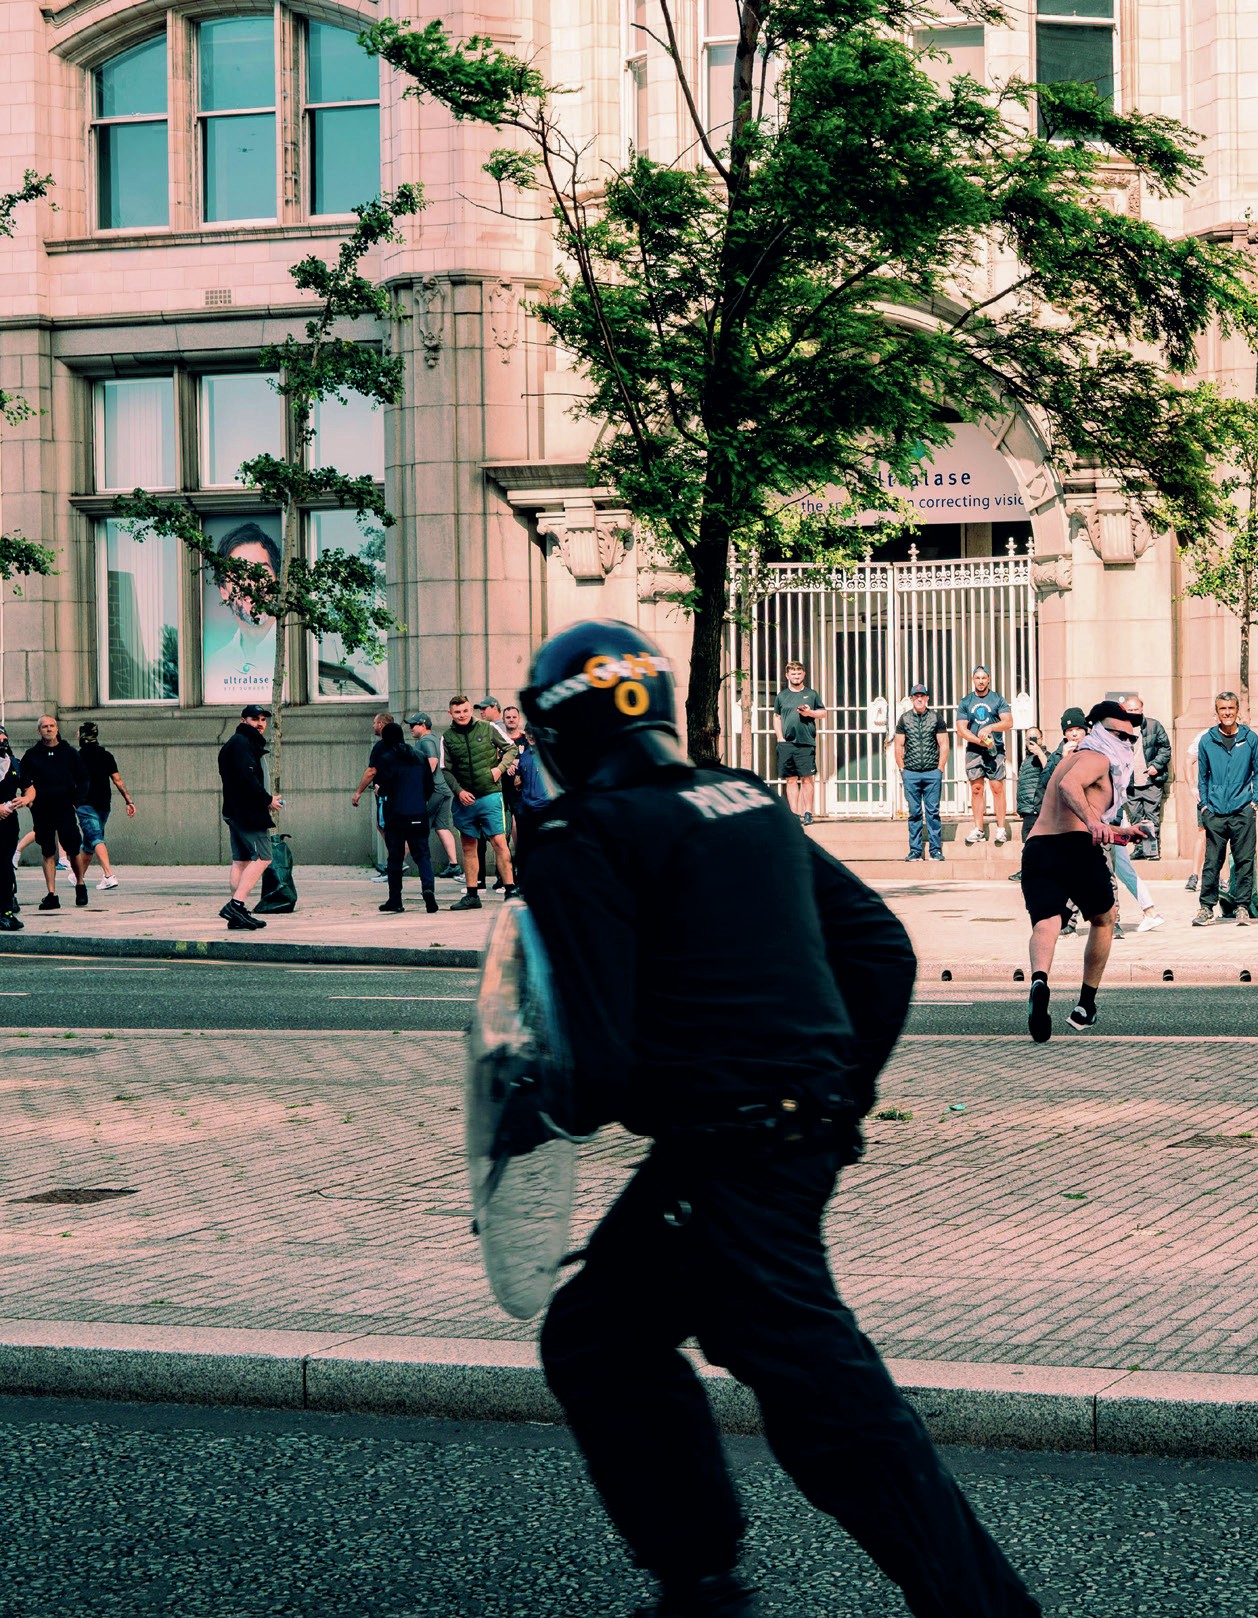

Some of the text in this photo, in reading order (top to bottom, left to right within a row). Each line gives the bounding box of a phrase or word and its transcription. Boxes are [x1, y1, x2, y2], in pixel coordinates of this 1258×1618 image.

[866, 471, 971, 488] ltalase
[801, 500, 824, 513] the
[919, 494, 990, 510] correcting
[994, 494, 1024, 507] visio
[223, 675, 269, 684] ultralase
[677, 781, 775, 819] POLICE
